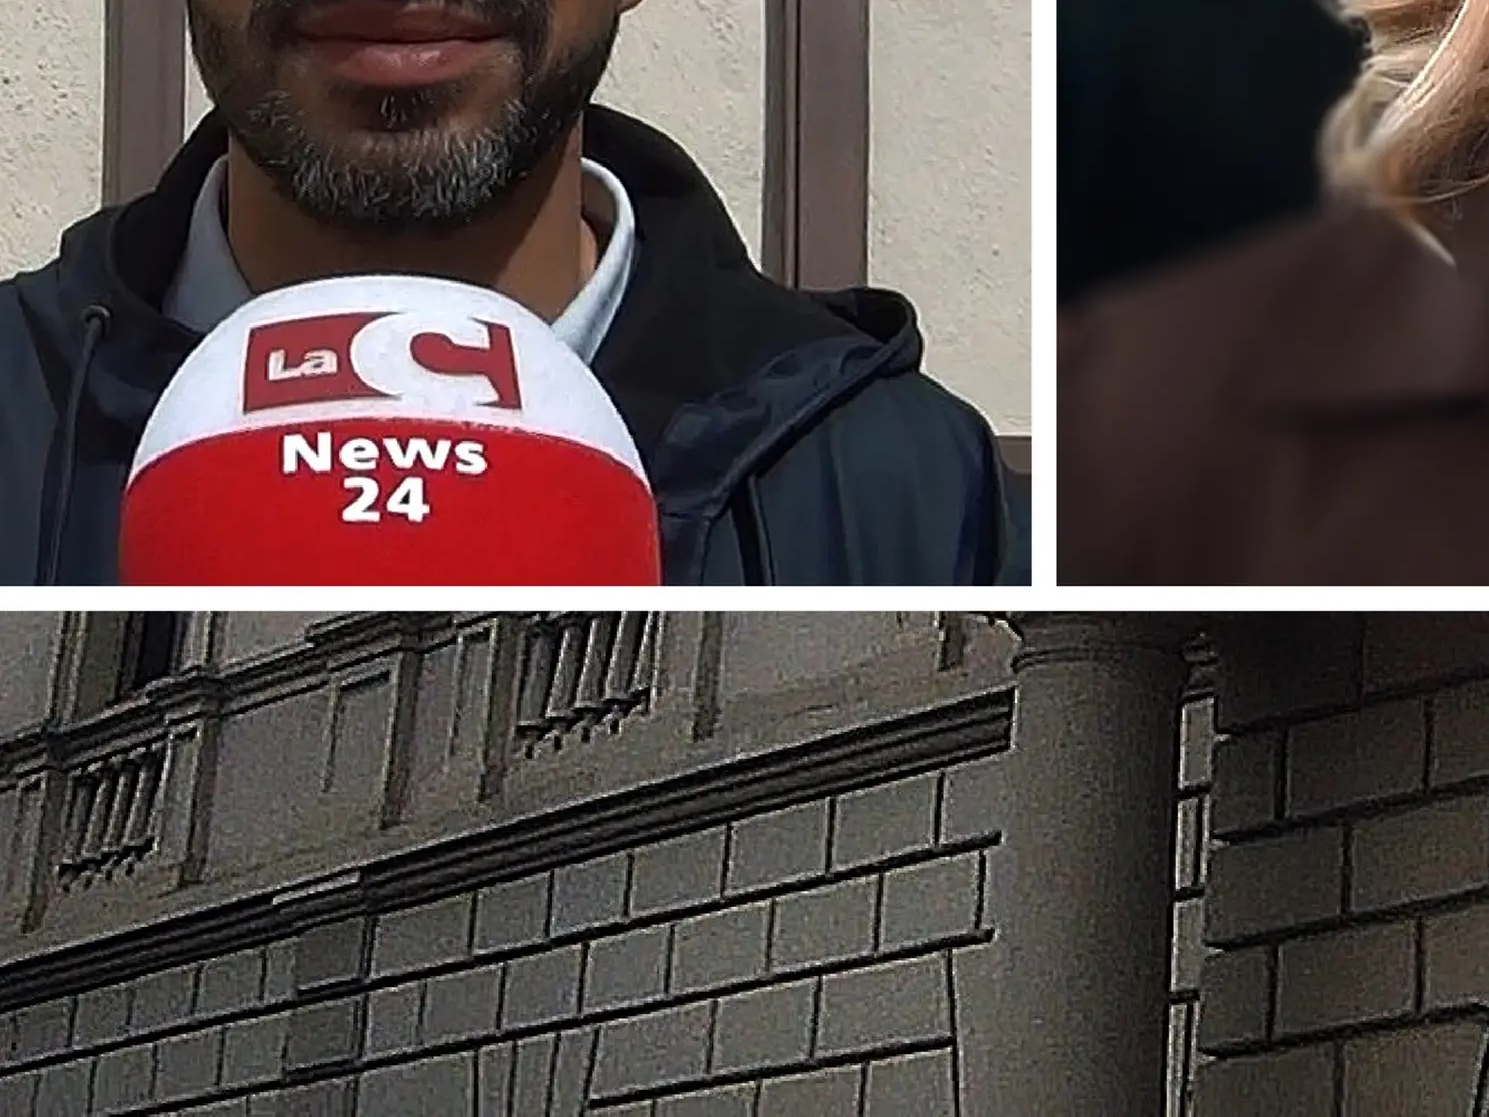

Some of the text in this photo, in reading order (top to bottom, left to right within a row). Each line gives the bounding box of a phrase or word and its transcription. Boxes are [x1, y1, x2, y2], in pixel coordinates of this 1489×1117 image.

[268, 348, 338, 382] La
[282, 431, 488, 475] News
[341, 476, 430, 523] 24
